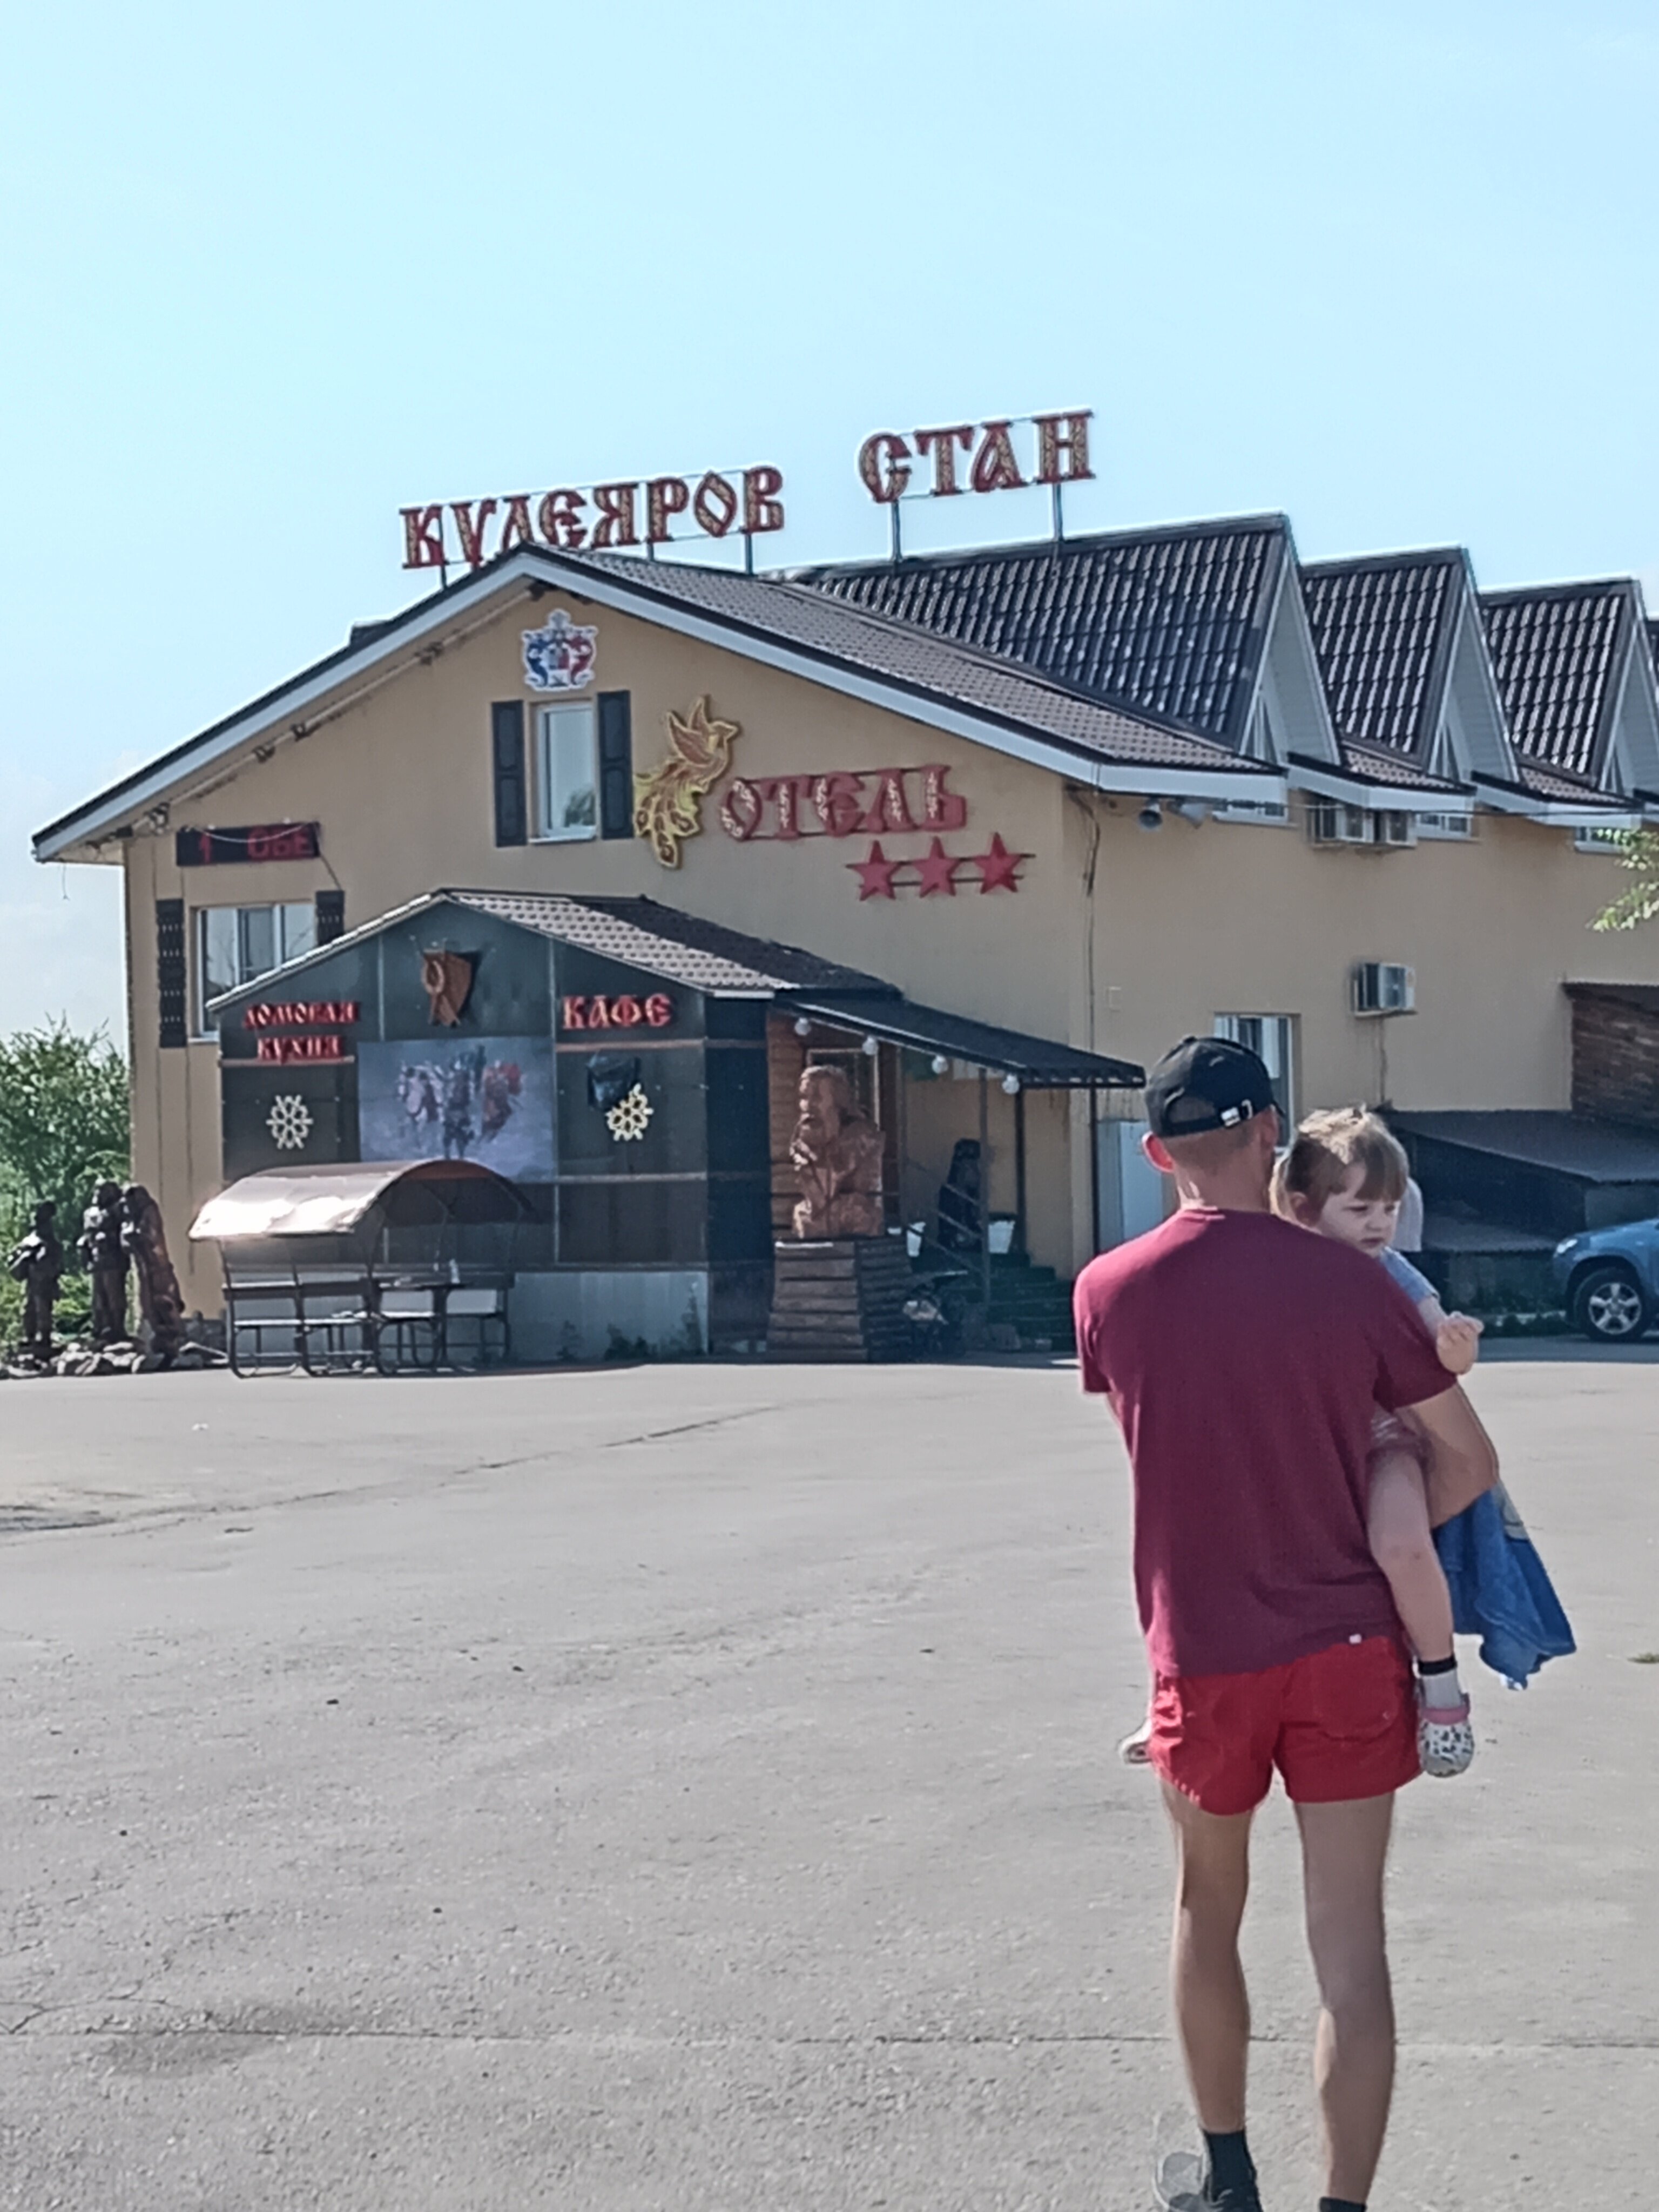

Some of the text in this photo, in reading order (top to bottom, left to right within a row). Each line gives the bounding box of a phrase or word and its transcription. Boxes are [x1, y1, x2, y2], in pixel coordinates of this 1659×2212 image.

[859, 409, 1096, 503] СТАН
[720, 765, 967, 842] ОТЕЛЬ
[563, 993, 671, 1029] КАФЕ
[256, 1035, 343, 1064] КУХНЯ
